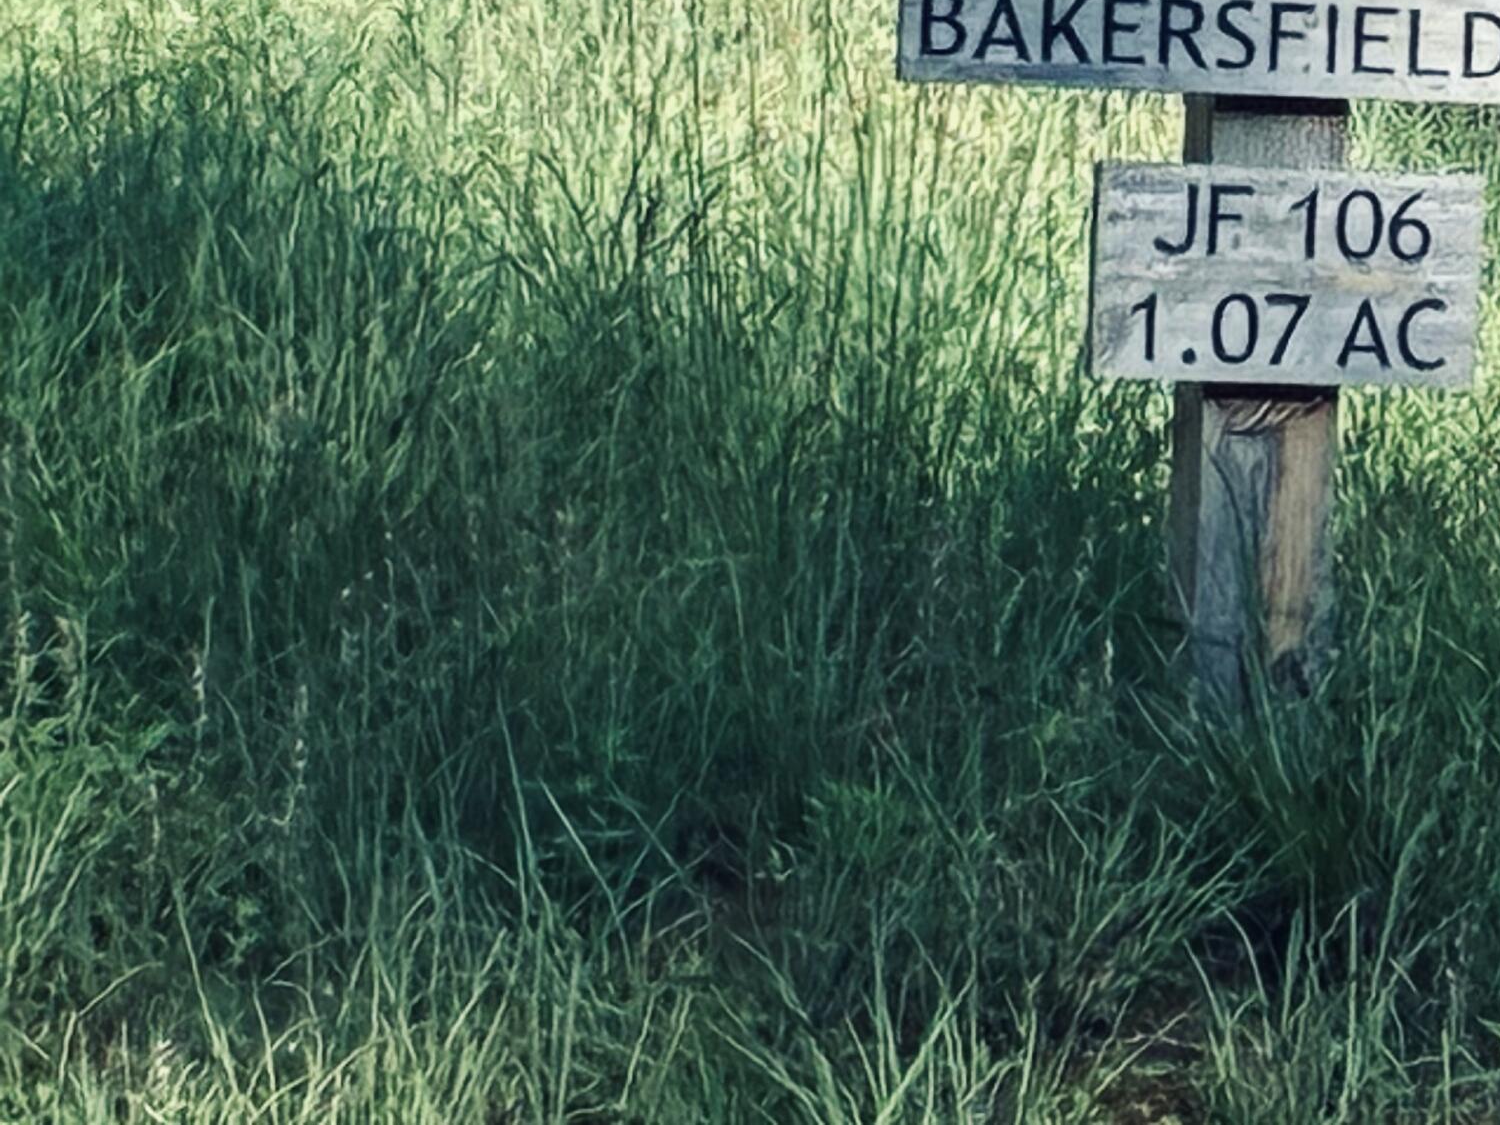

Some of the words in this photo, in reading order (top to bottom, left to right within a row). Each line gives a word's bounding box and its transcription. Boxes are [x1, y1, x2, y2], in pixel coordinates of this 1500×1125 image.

[1153, 183, 1255, 256] JF
[1289, 186, 1432, 263] 106
[1130, 292, 1312, 367] 1.07
[1336, 298, 1446, 371] AC
